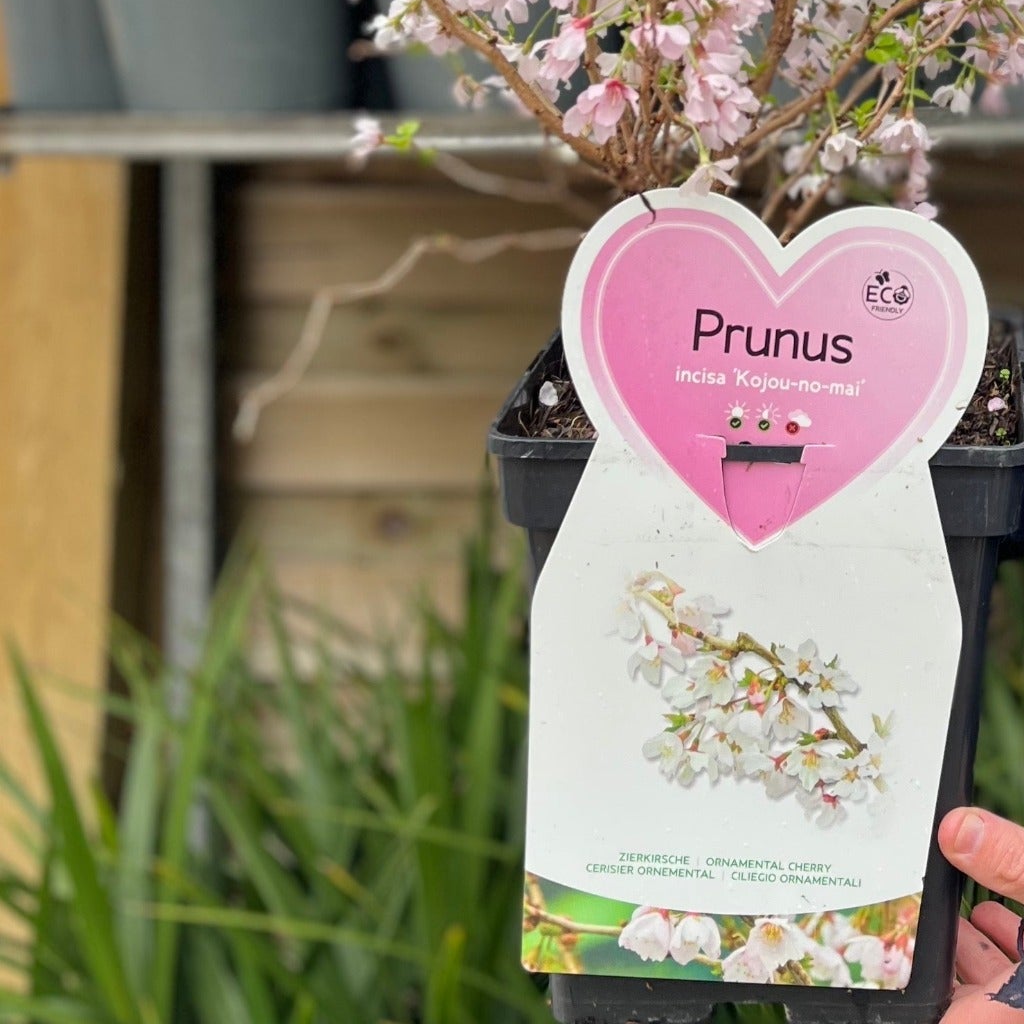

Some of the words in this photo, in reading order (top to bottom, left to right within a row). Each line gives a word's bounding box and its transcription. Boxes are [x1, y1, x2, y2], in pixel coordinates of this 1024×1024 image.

[866, 285, 911, 305] ECO
[871, 305, 904, 314] FRIENDLY
[692, 308, 854, 364] Prunus
[675, 366, 726, 385] incisa
[618, 852, 690, 865] ZIERKIRSCHE
[705, 857, 785, 871] ORNAMENTAL
[788, 861, 832, 873] CHERRY
[585, 863, 634, 875] CERISIER
[637, 866, 715, 880] ORNEMENTAL
[731, 871, 777, 883] CILIEGIO
[779, 874, 862, 888] ORNAMENTALI
